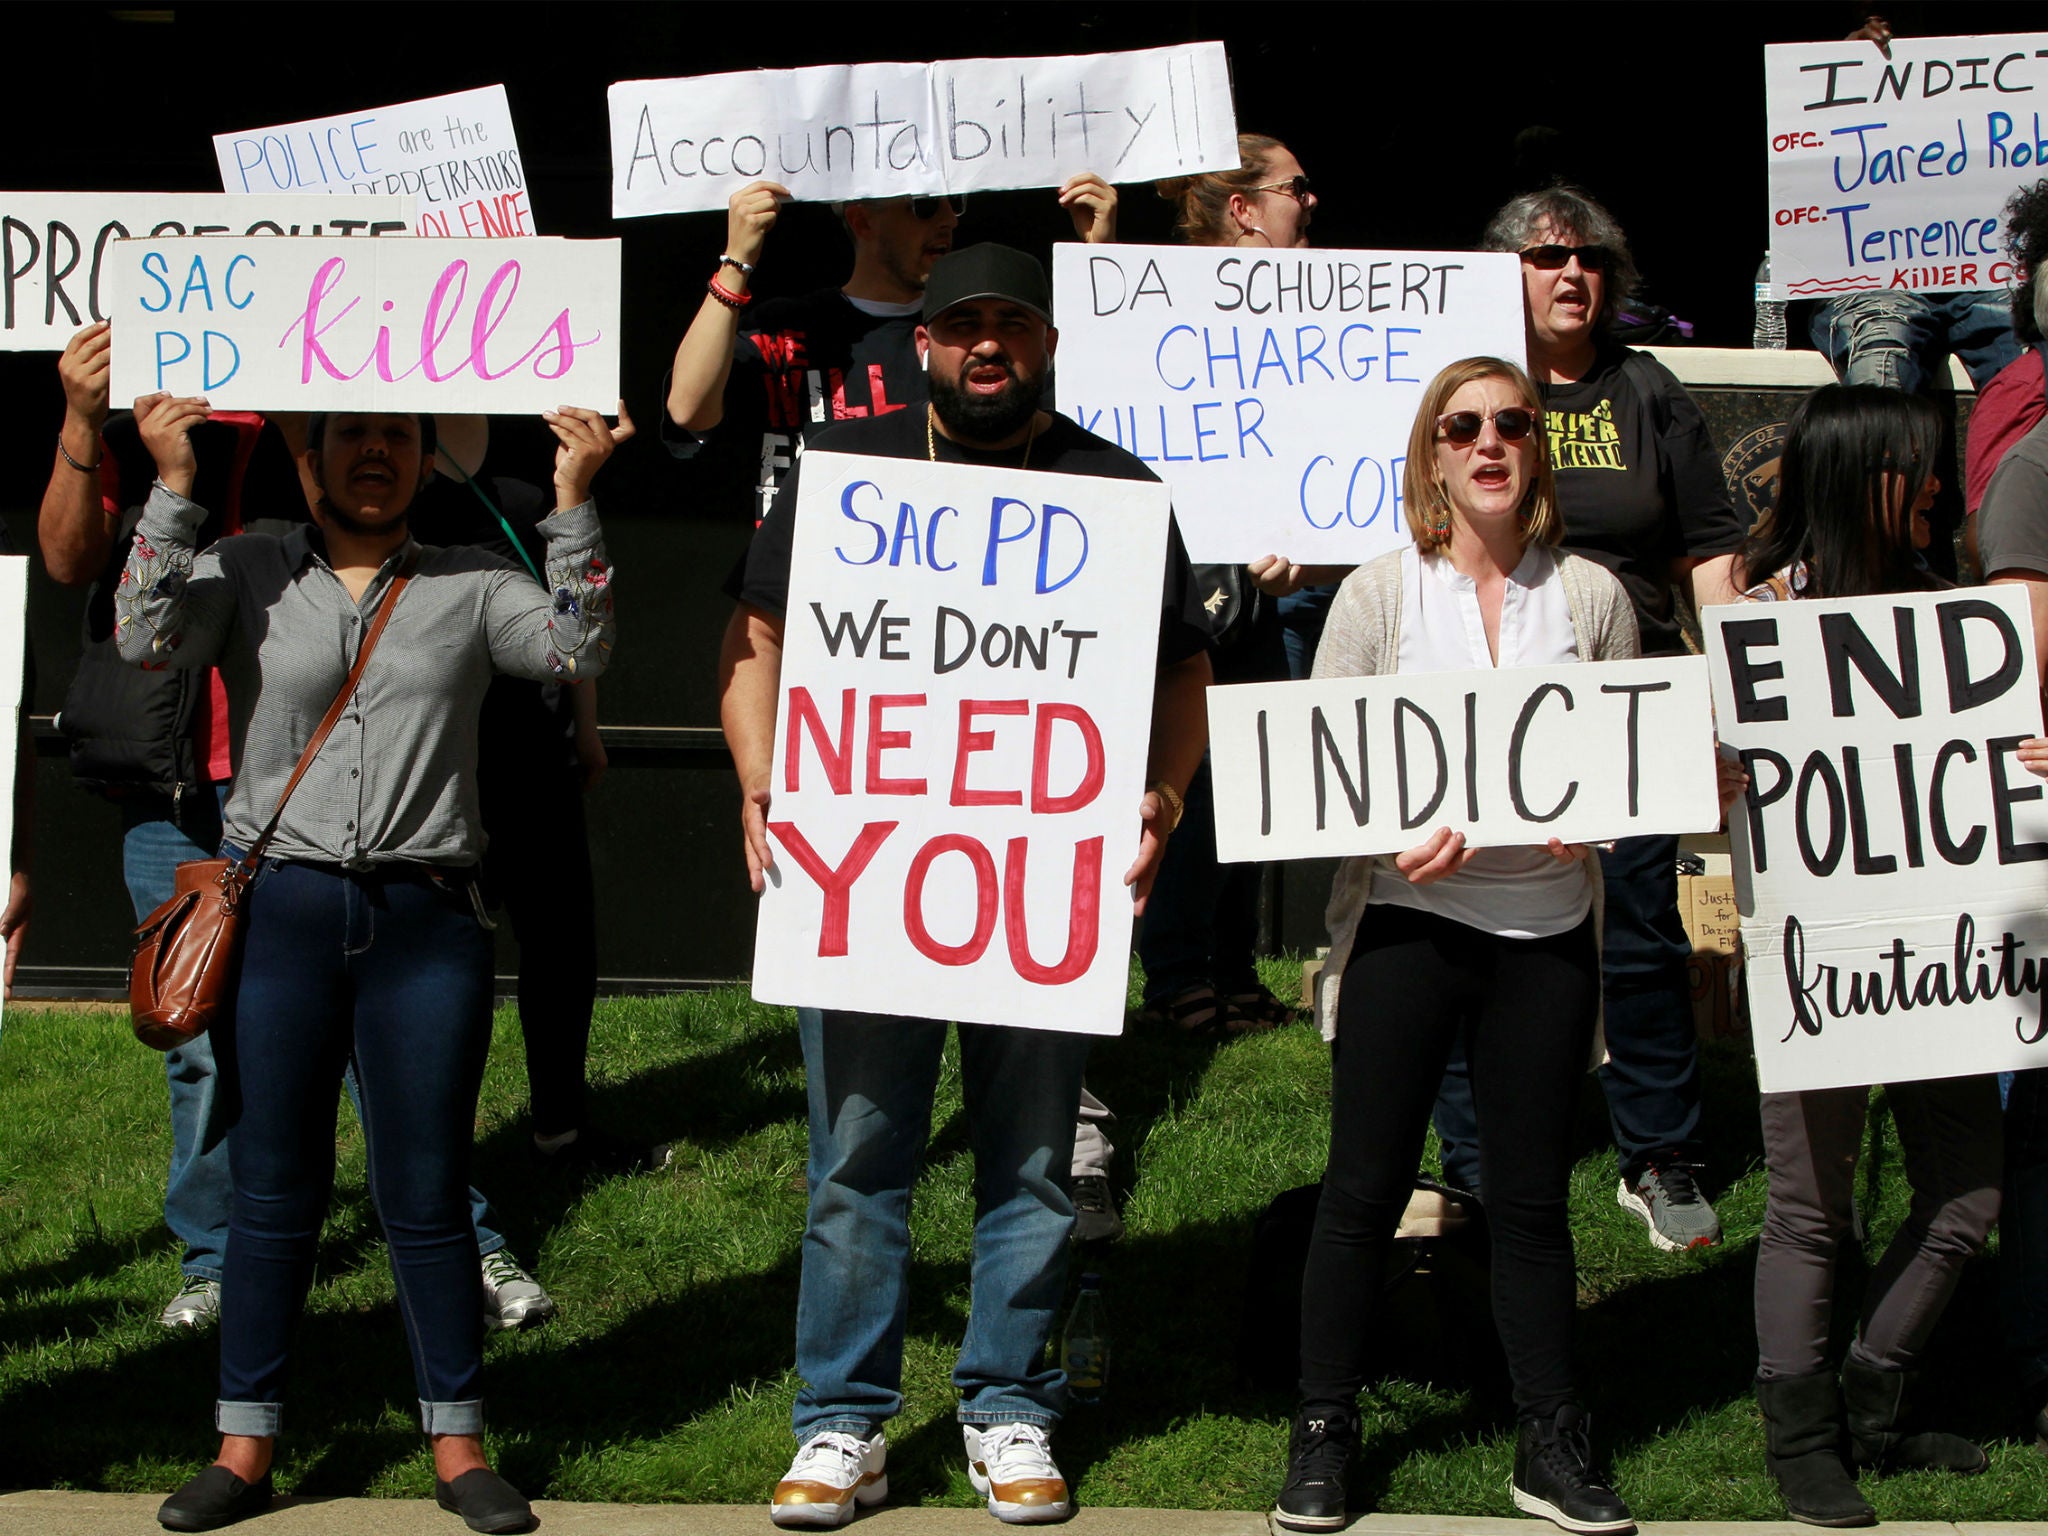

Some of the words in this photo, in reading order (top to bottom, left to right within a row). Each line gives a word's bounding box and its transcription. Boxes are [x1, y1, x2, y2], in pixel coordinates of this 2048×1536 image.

[234, 118, 381, 193] POLICE
[399, 127, 434, 155] are
[443, 115, 489, 149] the
[626, 54, 1205, 191] Accountability!!
[1773, 131, 1824, 153] OFC.
[1831, 118, 1968, 193] Jared
[1775, 206, 1827, 227] OFC.
[1827, 203, 1998, 267] Terrence
[139, 252, 256, 314] SAC
[1089, 256, 1173, 317] DA
[1214, 257, 1465, 316] SCHUBERT
[155, 330, 241, 392] PD
[1156, 323, 1422, 392] CHARGE
[834, 480, 959, 572] SAC
[981, 496, 1089, 595] PD
[809, 599, 911, 661] WE
[933, 605, 1099, 680] DON'T
[1720, 600, 2024, 725] END
[784, 685, 1106, 815] NEED
[1257, 681, 1672, 837] INDICT
[1739, 734, 2048, 878] POLICE
[767, 820, 1105, 986] YOU
[1715, 908, 1734, 922] for
[1781, 913, 2048, 1044] brutality
